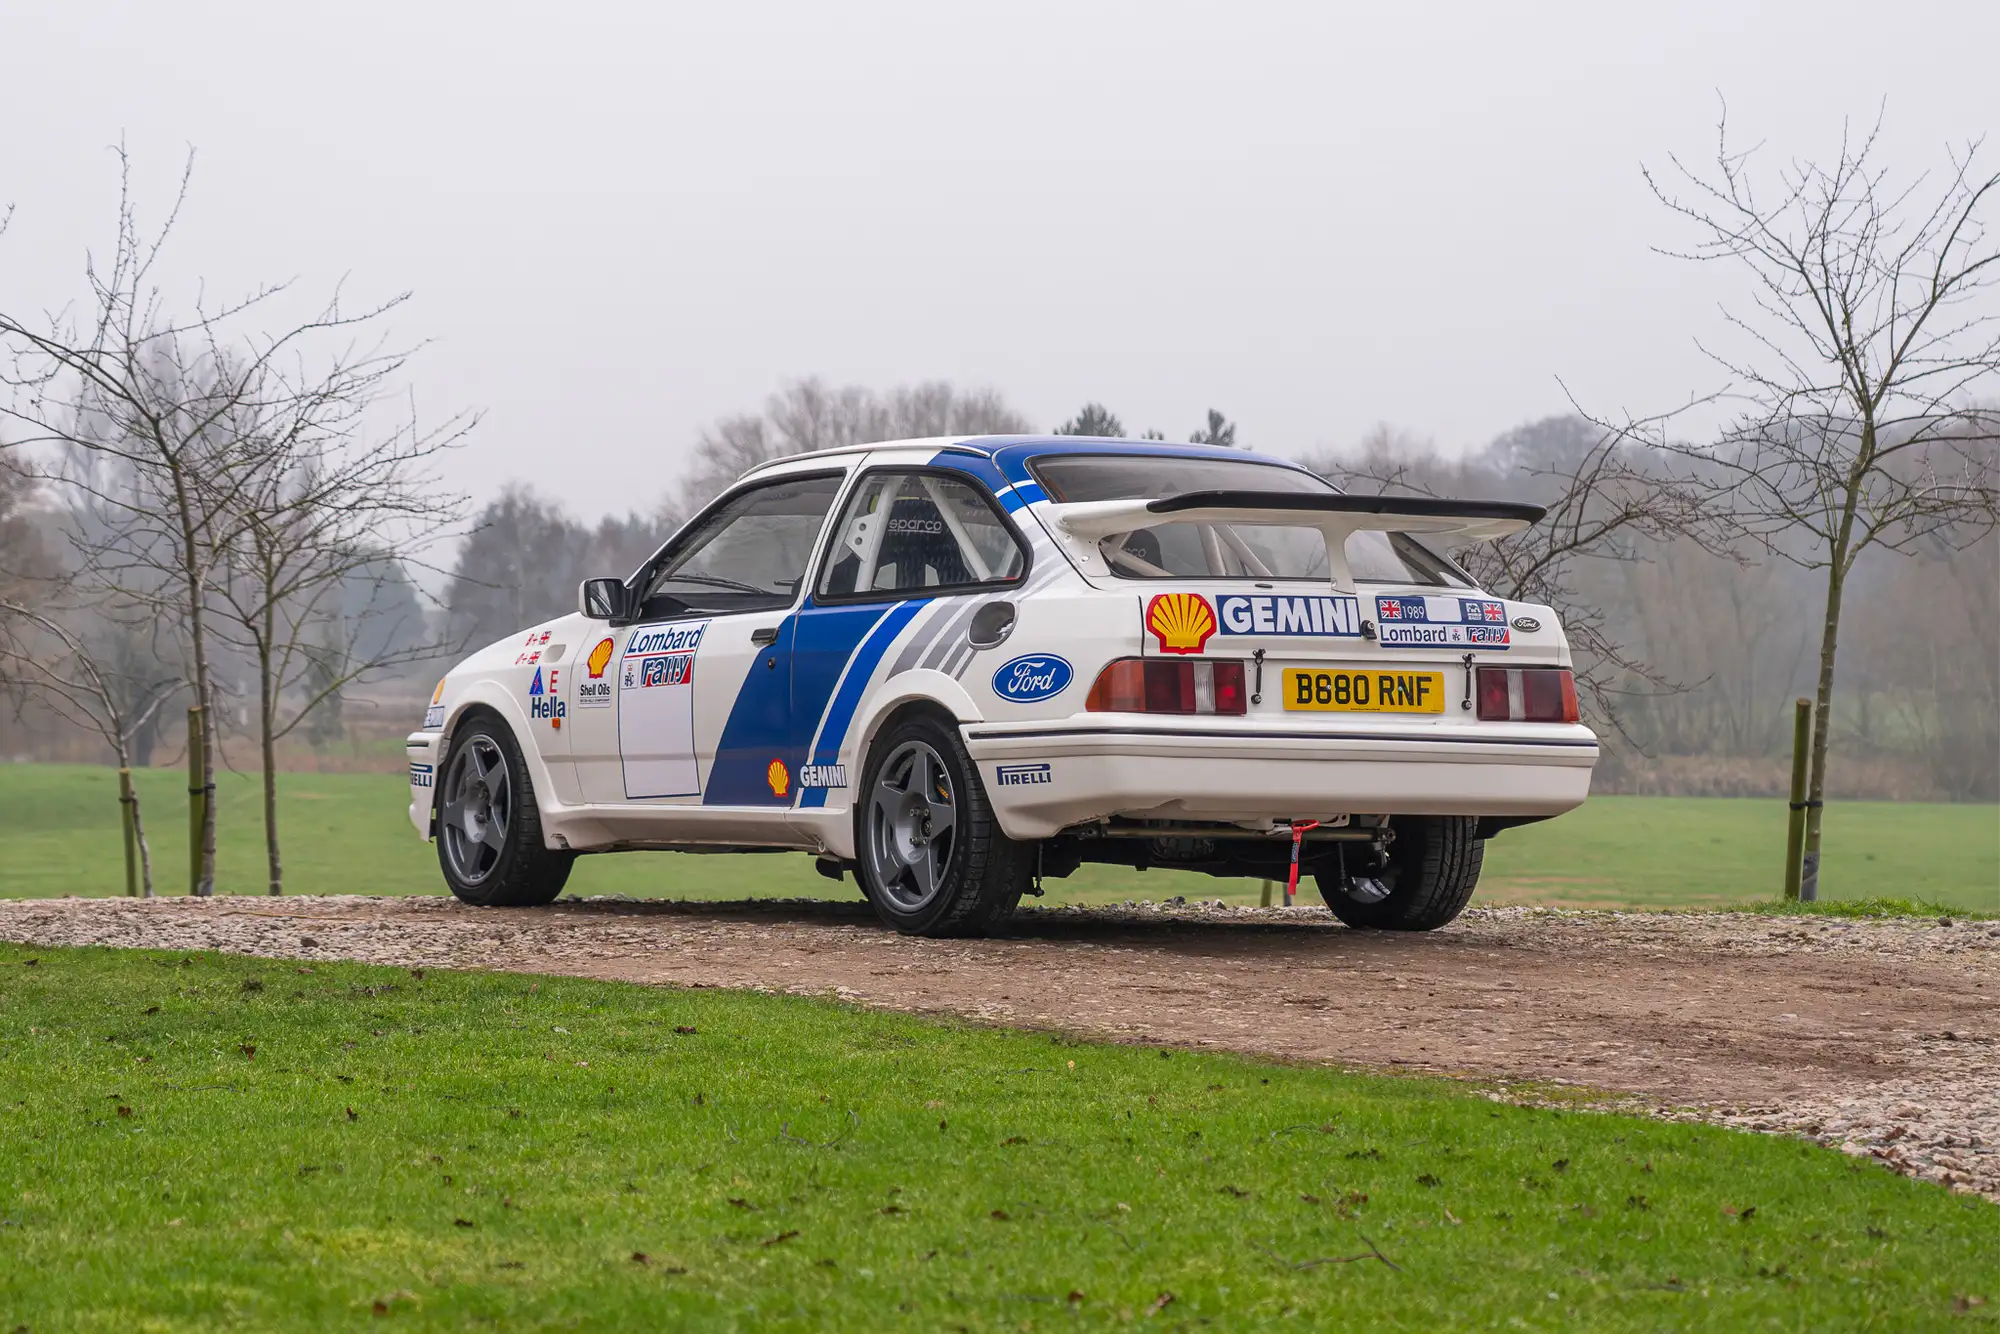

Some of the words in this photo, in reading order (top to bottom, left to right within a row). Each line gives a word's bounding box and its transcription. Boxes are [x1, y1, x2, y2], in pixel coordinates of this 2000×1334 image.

[888, 517, 942, 533] sparco
[1222, 597, 1360, 635] GEMINI
[1402, 606, 1424, 619] 1989
[1516, 618, 1538, 629] Ford
[627, 623, 706, 653] Lombard
[1380, 625, 1447, 642] Lombard
[1468, 627, 1506, 643] rally
[641, 654, 691, 687] rally
[1008, 661, 1057, 693] Ford
[579, 684, 597, 696] Shell
[597, 683, 611, 695] Oils
[1295, 673, 1370, 705] B880
[1378, 675, 1433, 706] RNF
[531, 696, 566, 719] Hella
[799, 764, 847, 788] GEMINI
[996, 763, 1052, 786] PIRELLI
